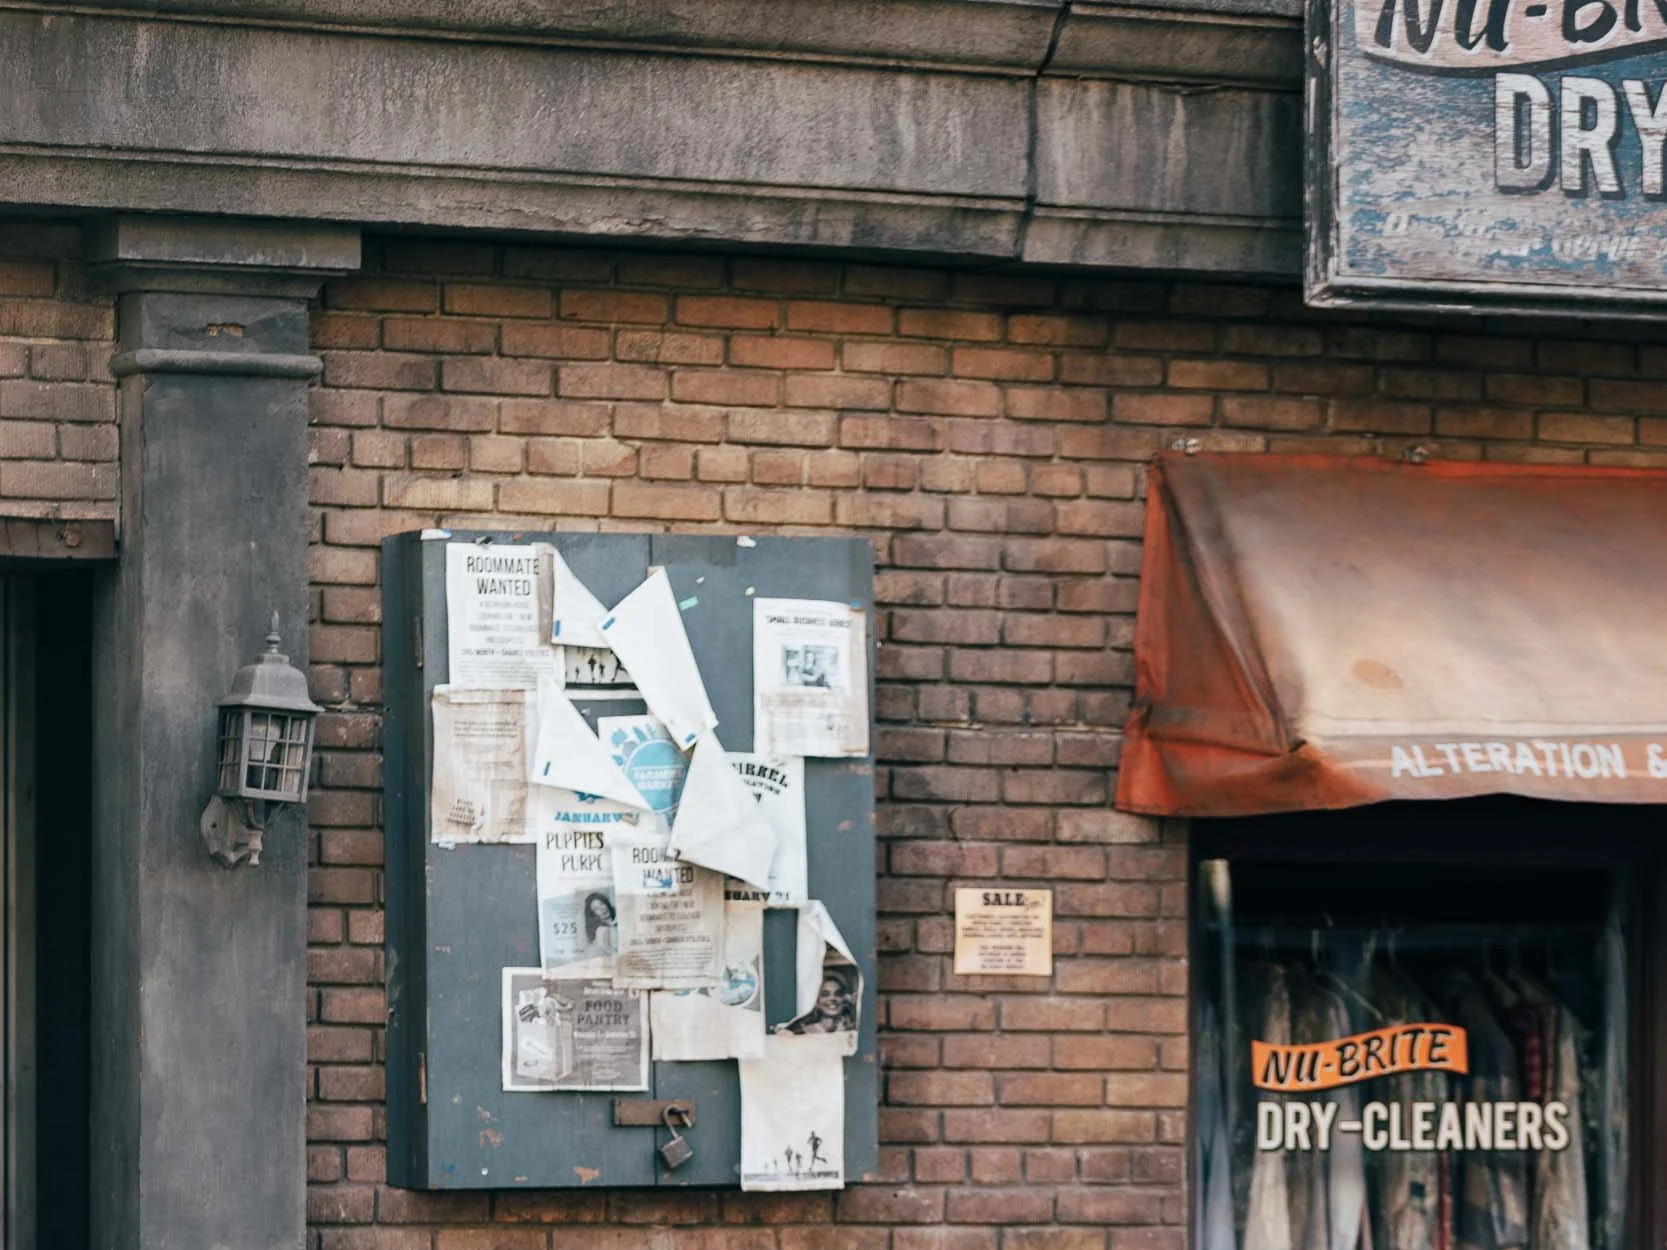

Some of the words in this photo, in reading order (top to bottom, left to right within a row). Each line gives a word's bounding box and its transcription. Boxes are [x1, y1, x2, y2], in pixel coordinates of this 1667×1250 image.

[1495, 72, 1667, 196] DRY
[467, 556, 540, 575] ROOMMATE
[477, 578, 531, 596] WANTED
[1391, 739, 1627, 779] ALTERATION
[983, 892, 1025, 906] SALE
[585, 1000, 623, 1012] FOOD
[577, 1013, 630, 1026] PANTRY
[1261, 1028, 1452, 1086] NU-BRITE
[1257, 1101, 1570, 1151] DRY-CLEANERS
